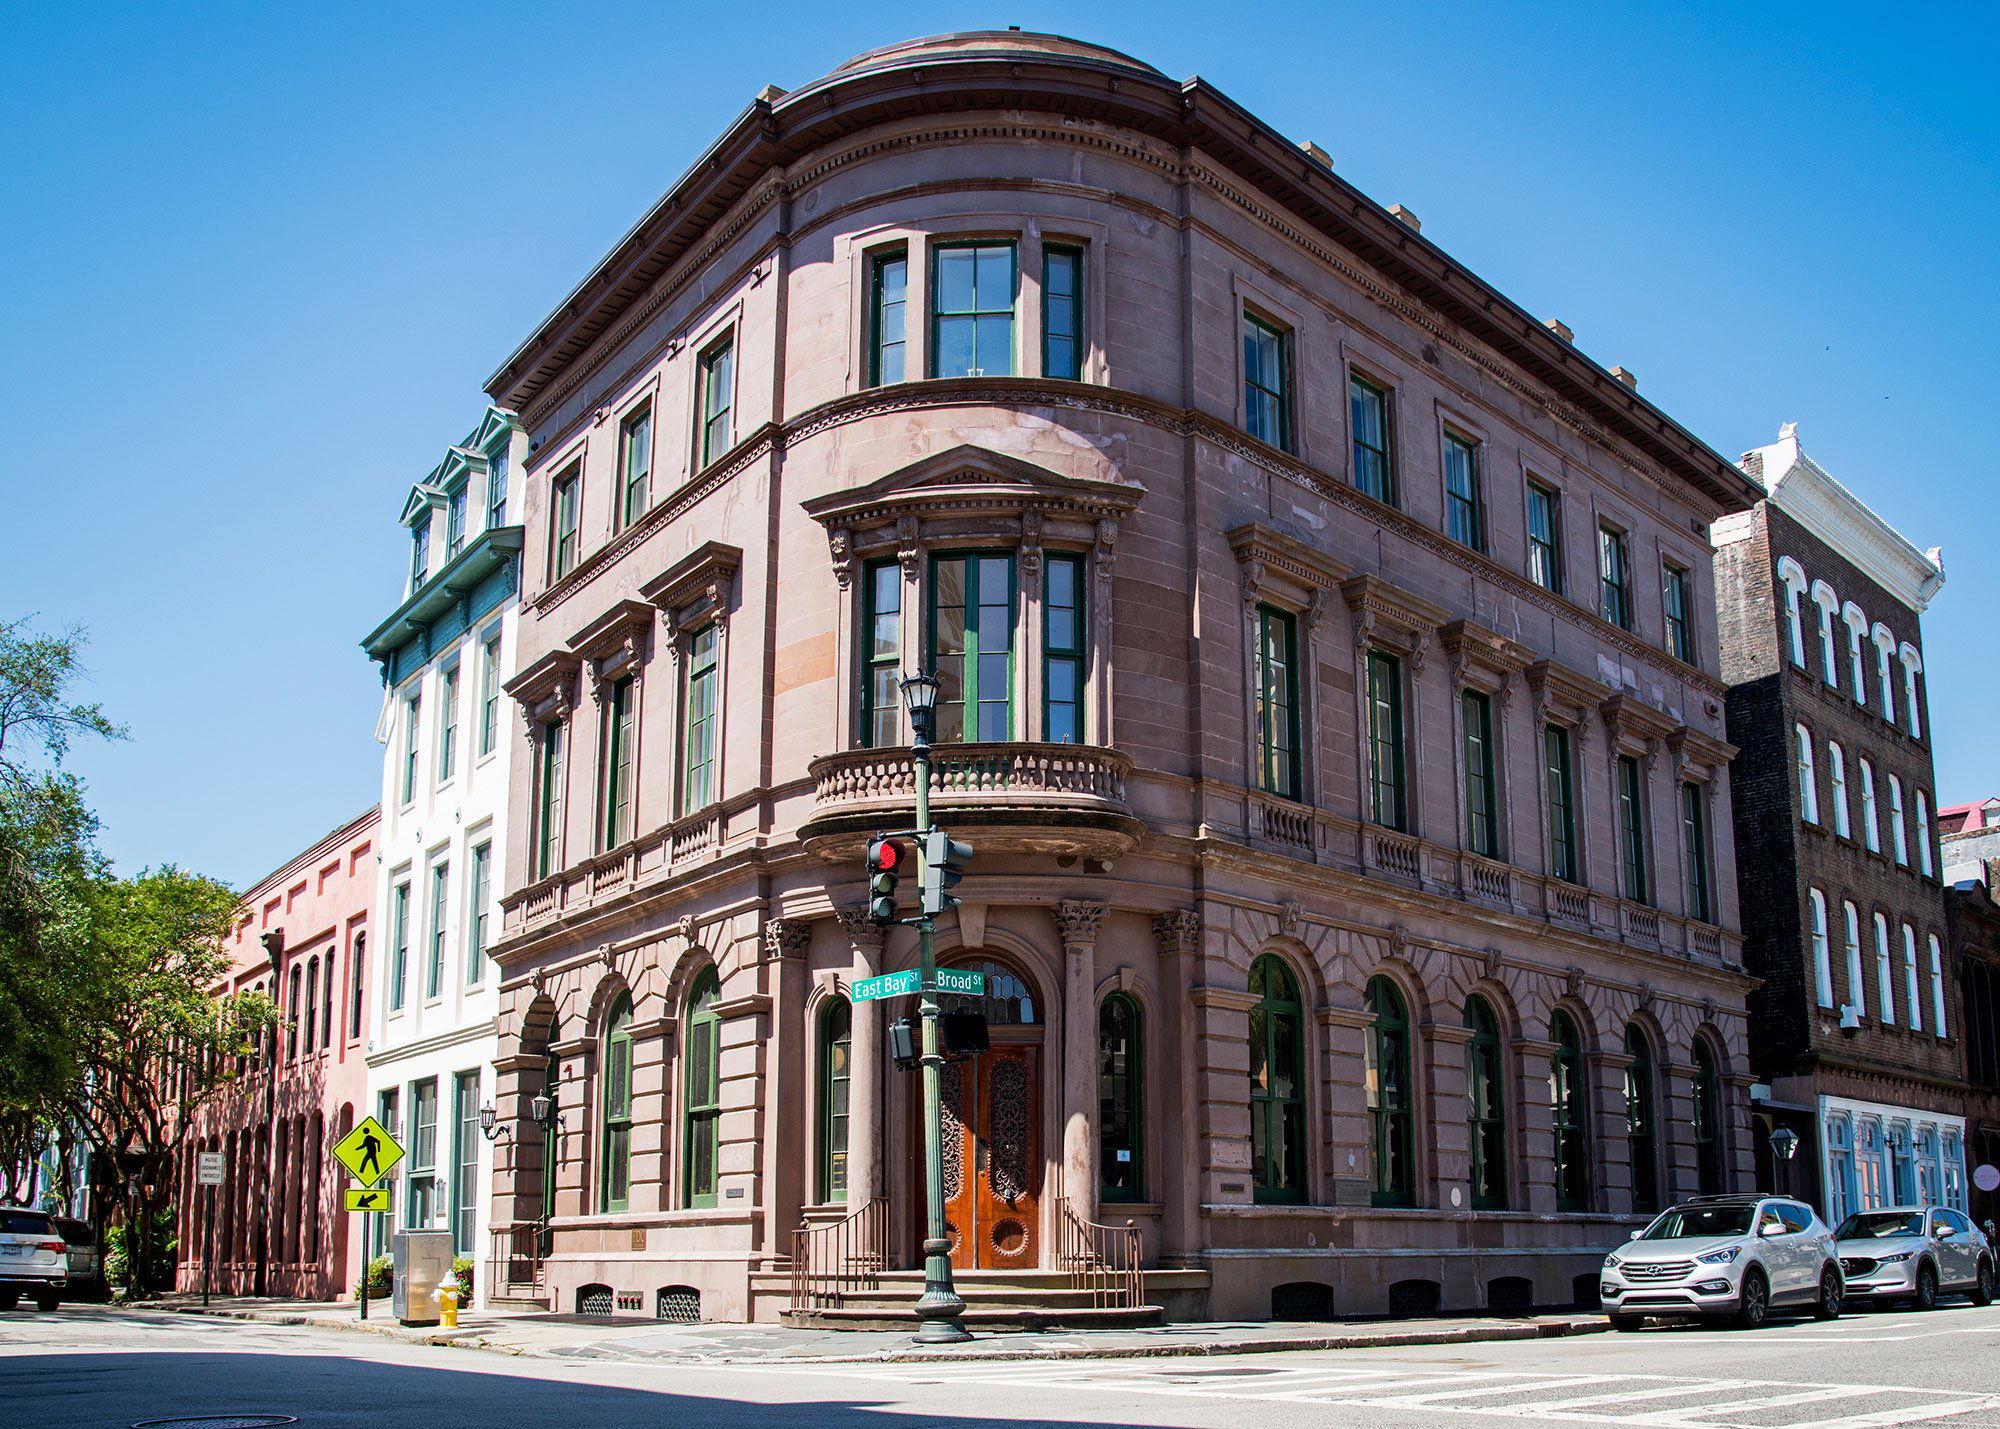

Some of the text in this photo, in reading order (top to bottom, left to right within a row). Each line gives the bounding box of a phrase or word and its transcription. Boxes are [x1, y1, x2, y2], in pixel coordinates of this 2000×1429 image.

[855, 971, 918, 998] East Bay St
[937, 971, 982, 989] Broad St
